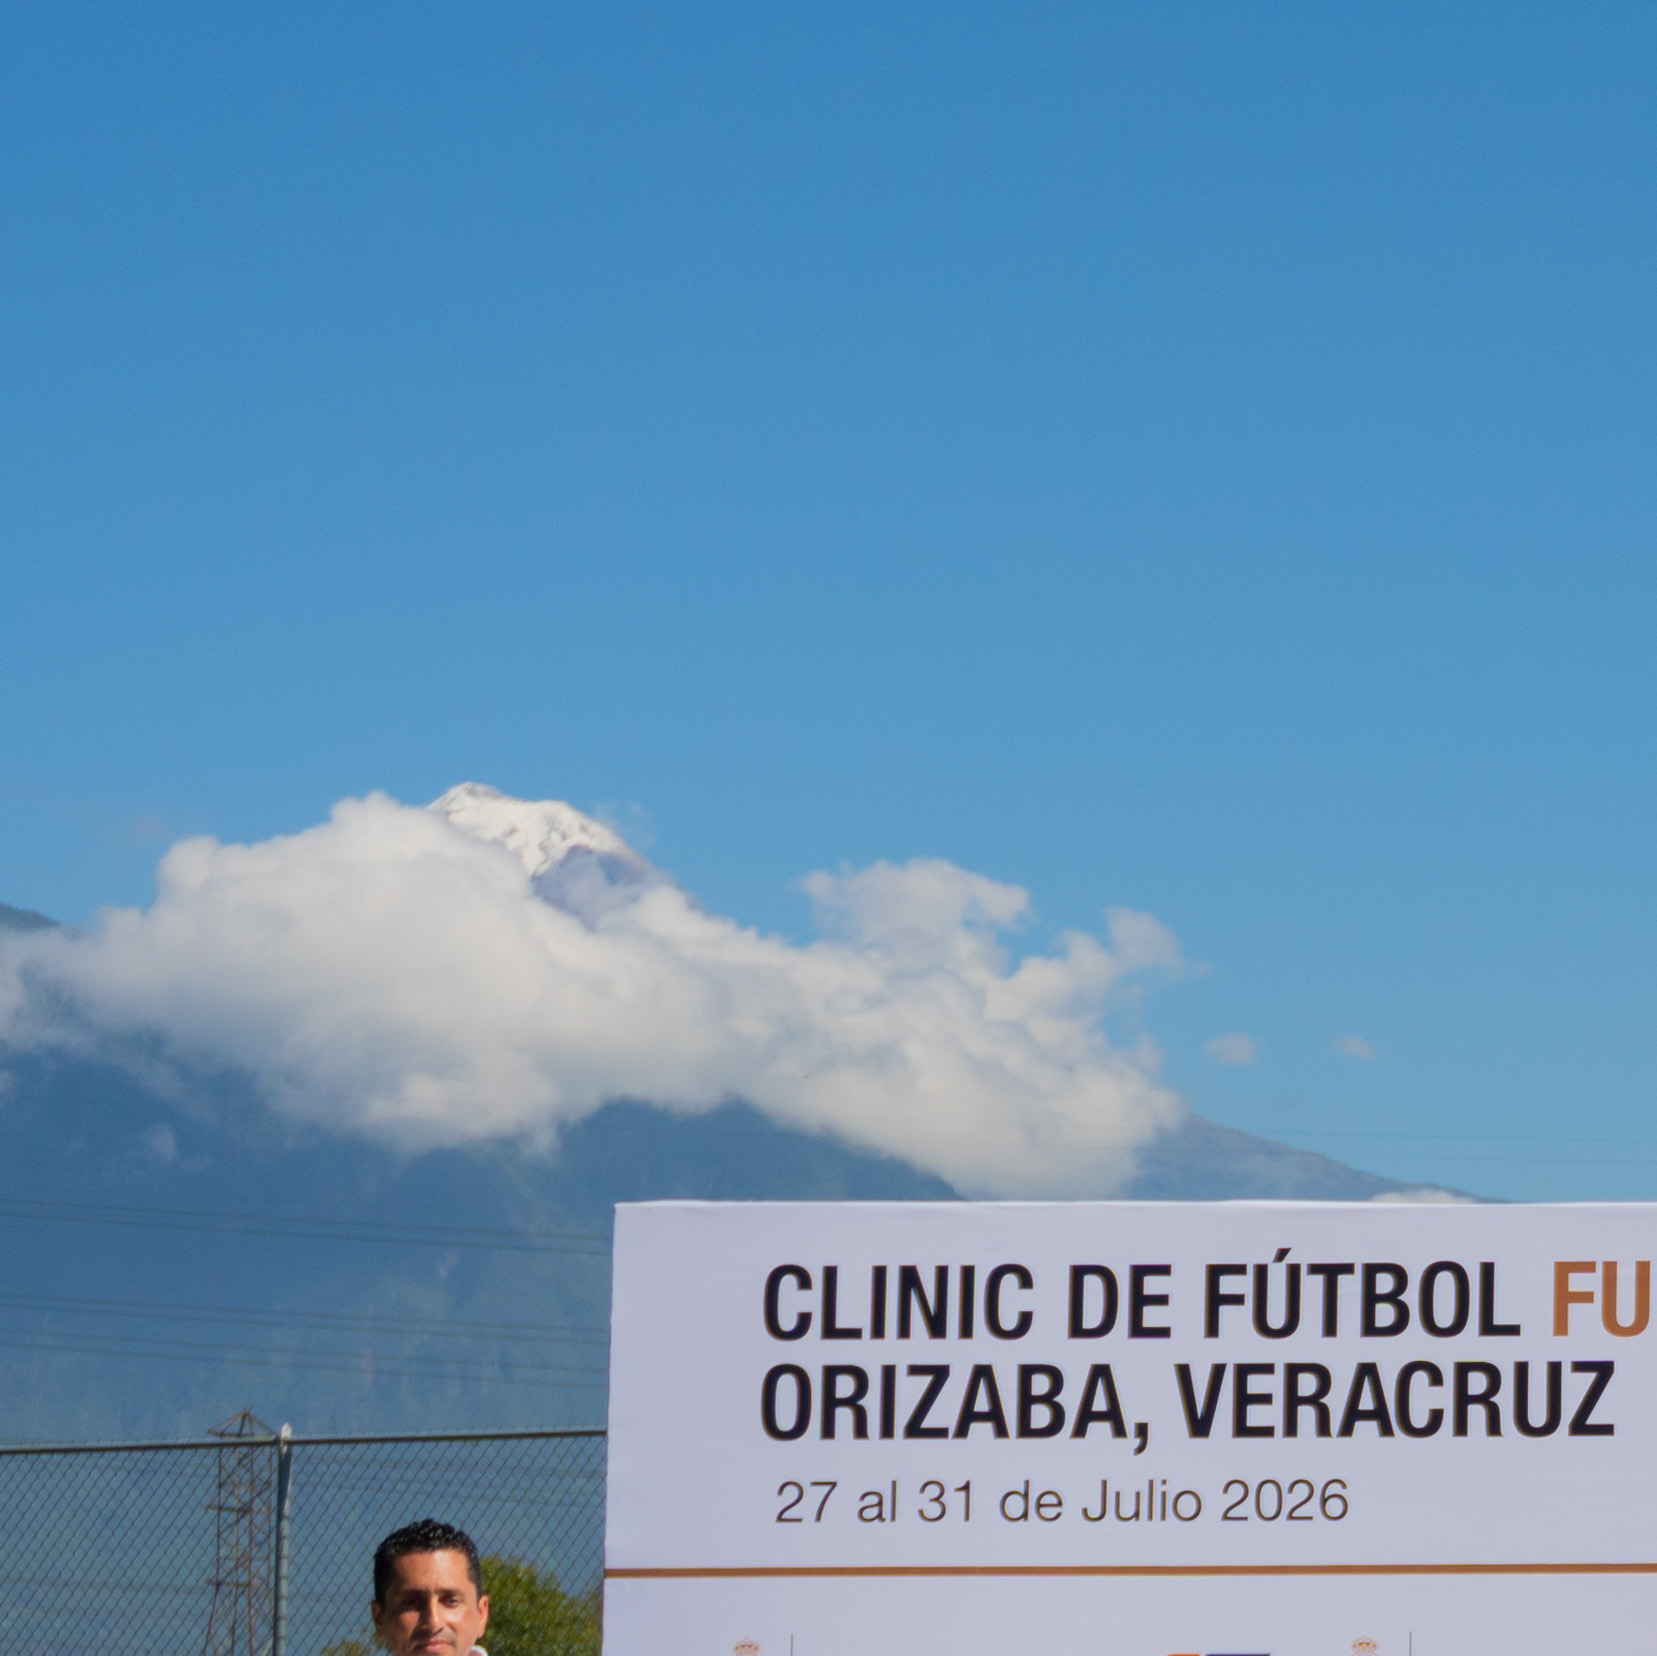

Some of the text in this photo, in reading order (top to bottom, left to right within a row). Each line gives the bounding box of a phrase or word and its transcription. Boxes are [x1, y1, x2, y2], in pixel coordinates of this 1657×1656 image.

[764, 1264, 1033, 1341] CLINIC
[1068, 1264, 1171, 1339] DE
[1205, 1248, 1520, 1339] FÚTBOL
[761, 1361, 1614, 1455] ORIZABA, VERACRUZ
[776, 1479, 1348, 1522] 27 al 31 de Julio 2026
